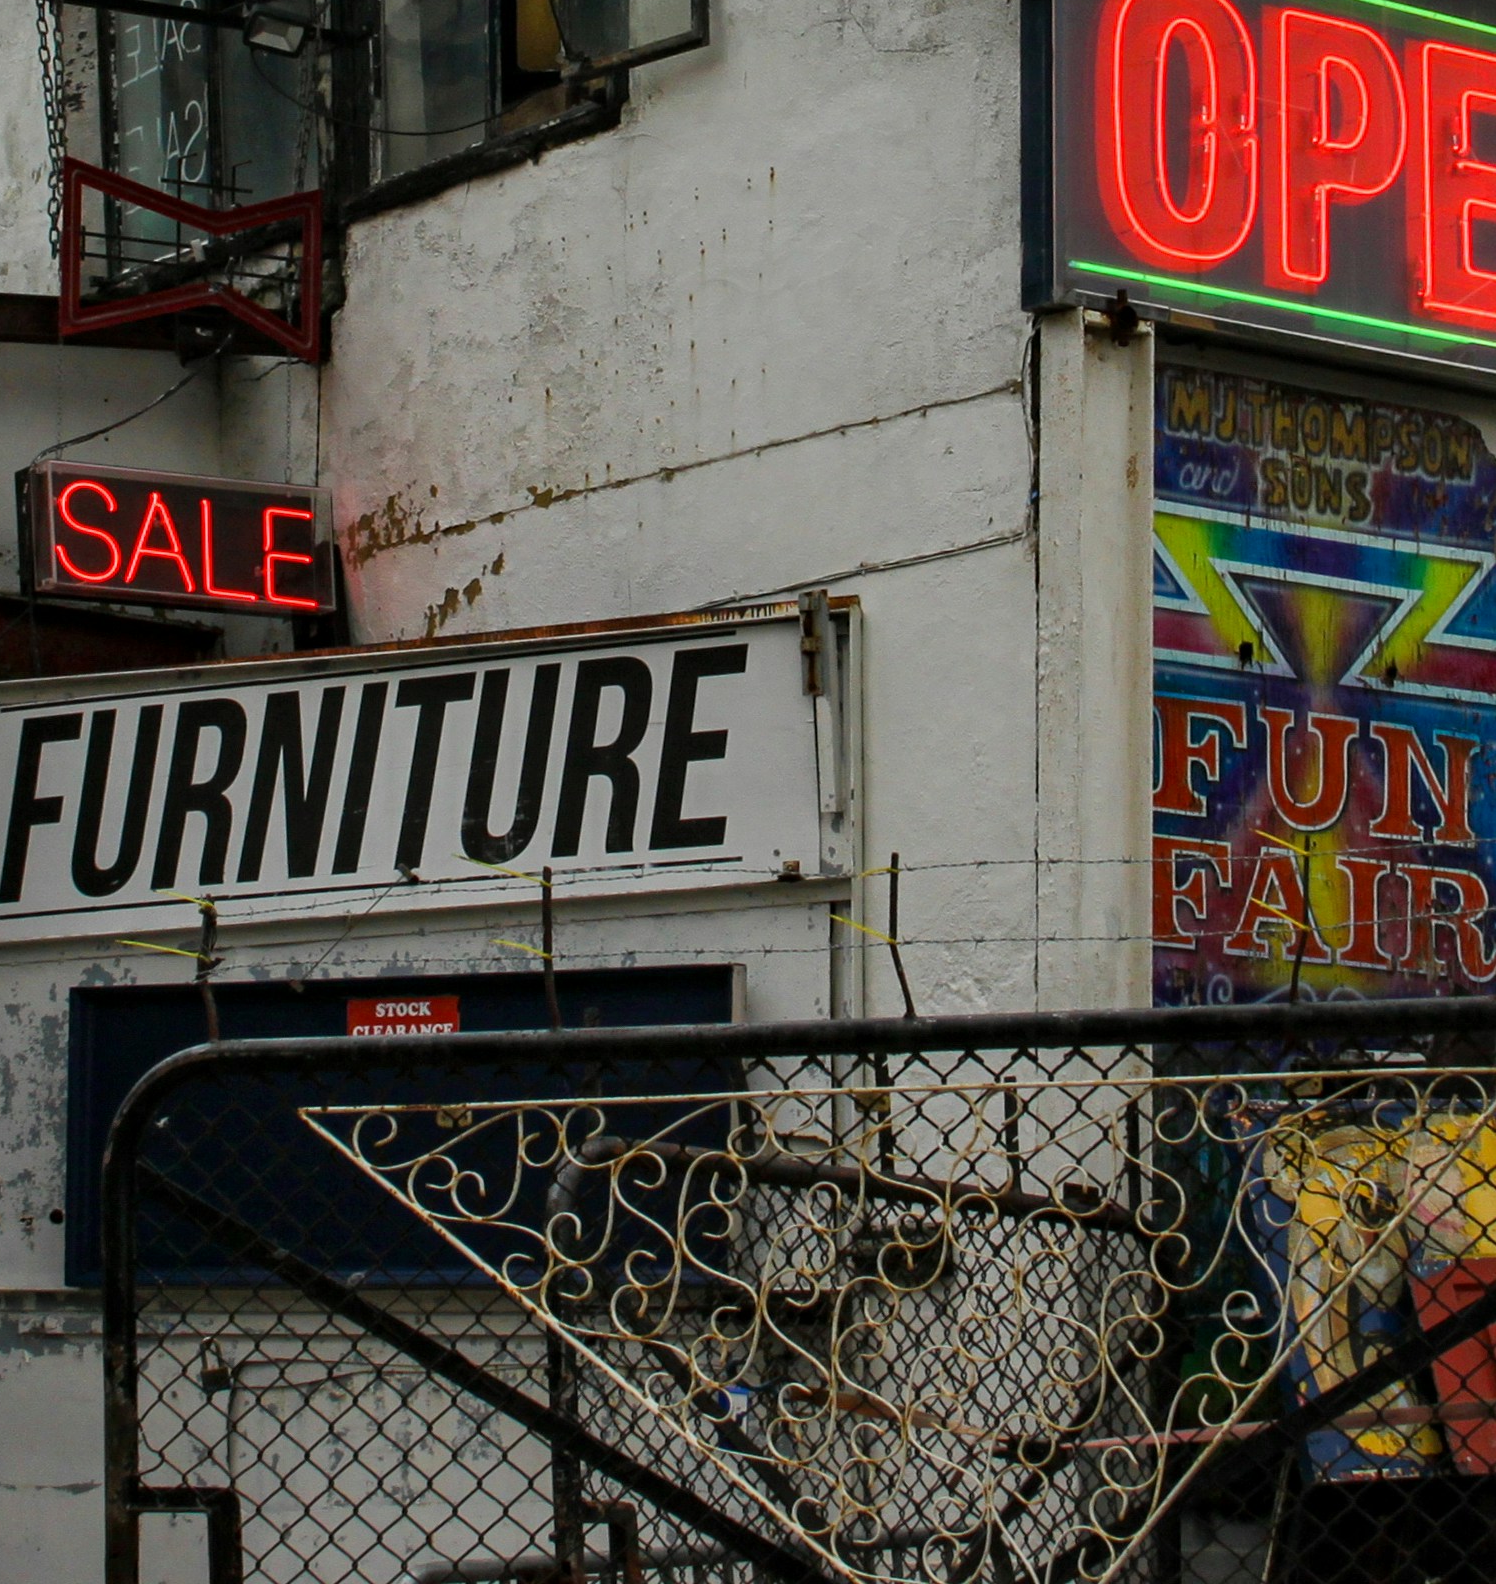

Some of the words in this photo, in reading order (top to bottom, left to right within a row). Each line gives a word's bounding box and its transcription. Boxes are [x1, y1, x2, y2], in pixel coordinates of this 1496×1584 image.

[56, 479, 319, 610] SALE
[1152, 694, 1481, 848] FUN
[375, 1001, 432, 1018] STOCK
